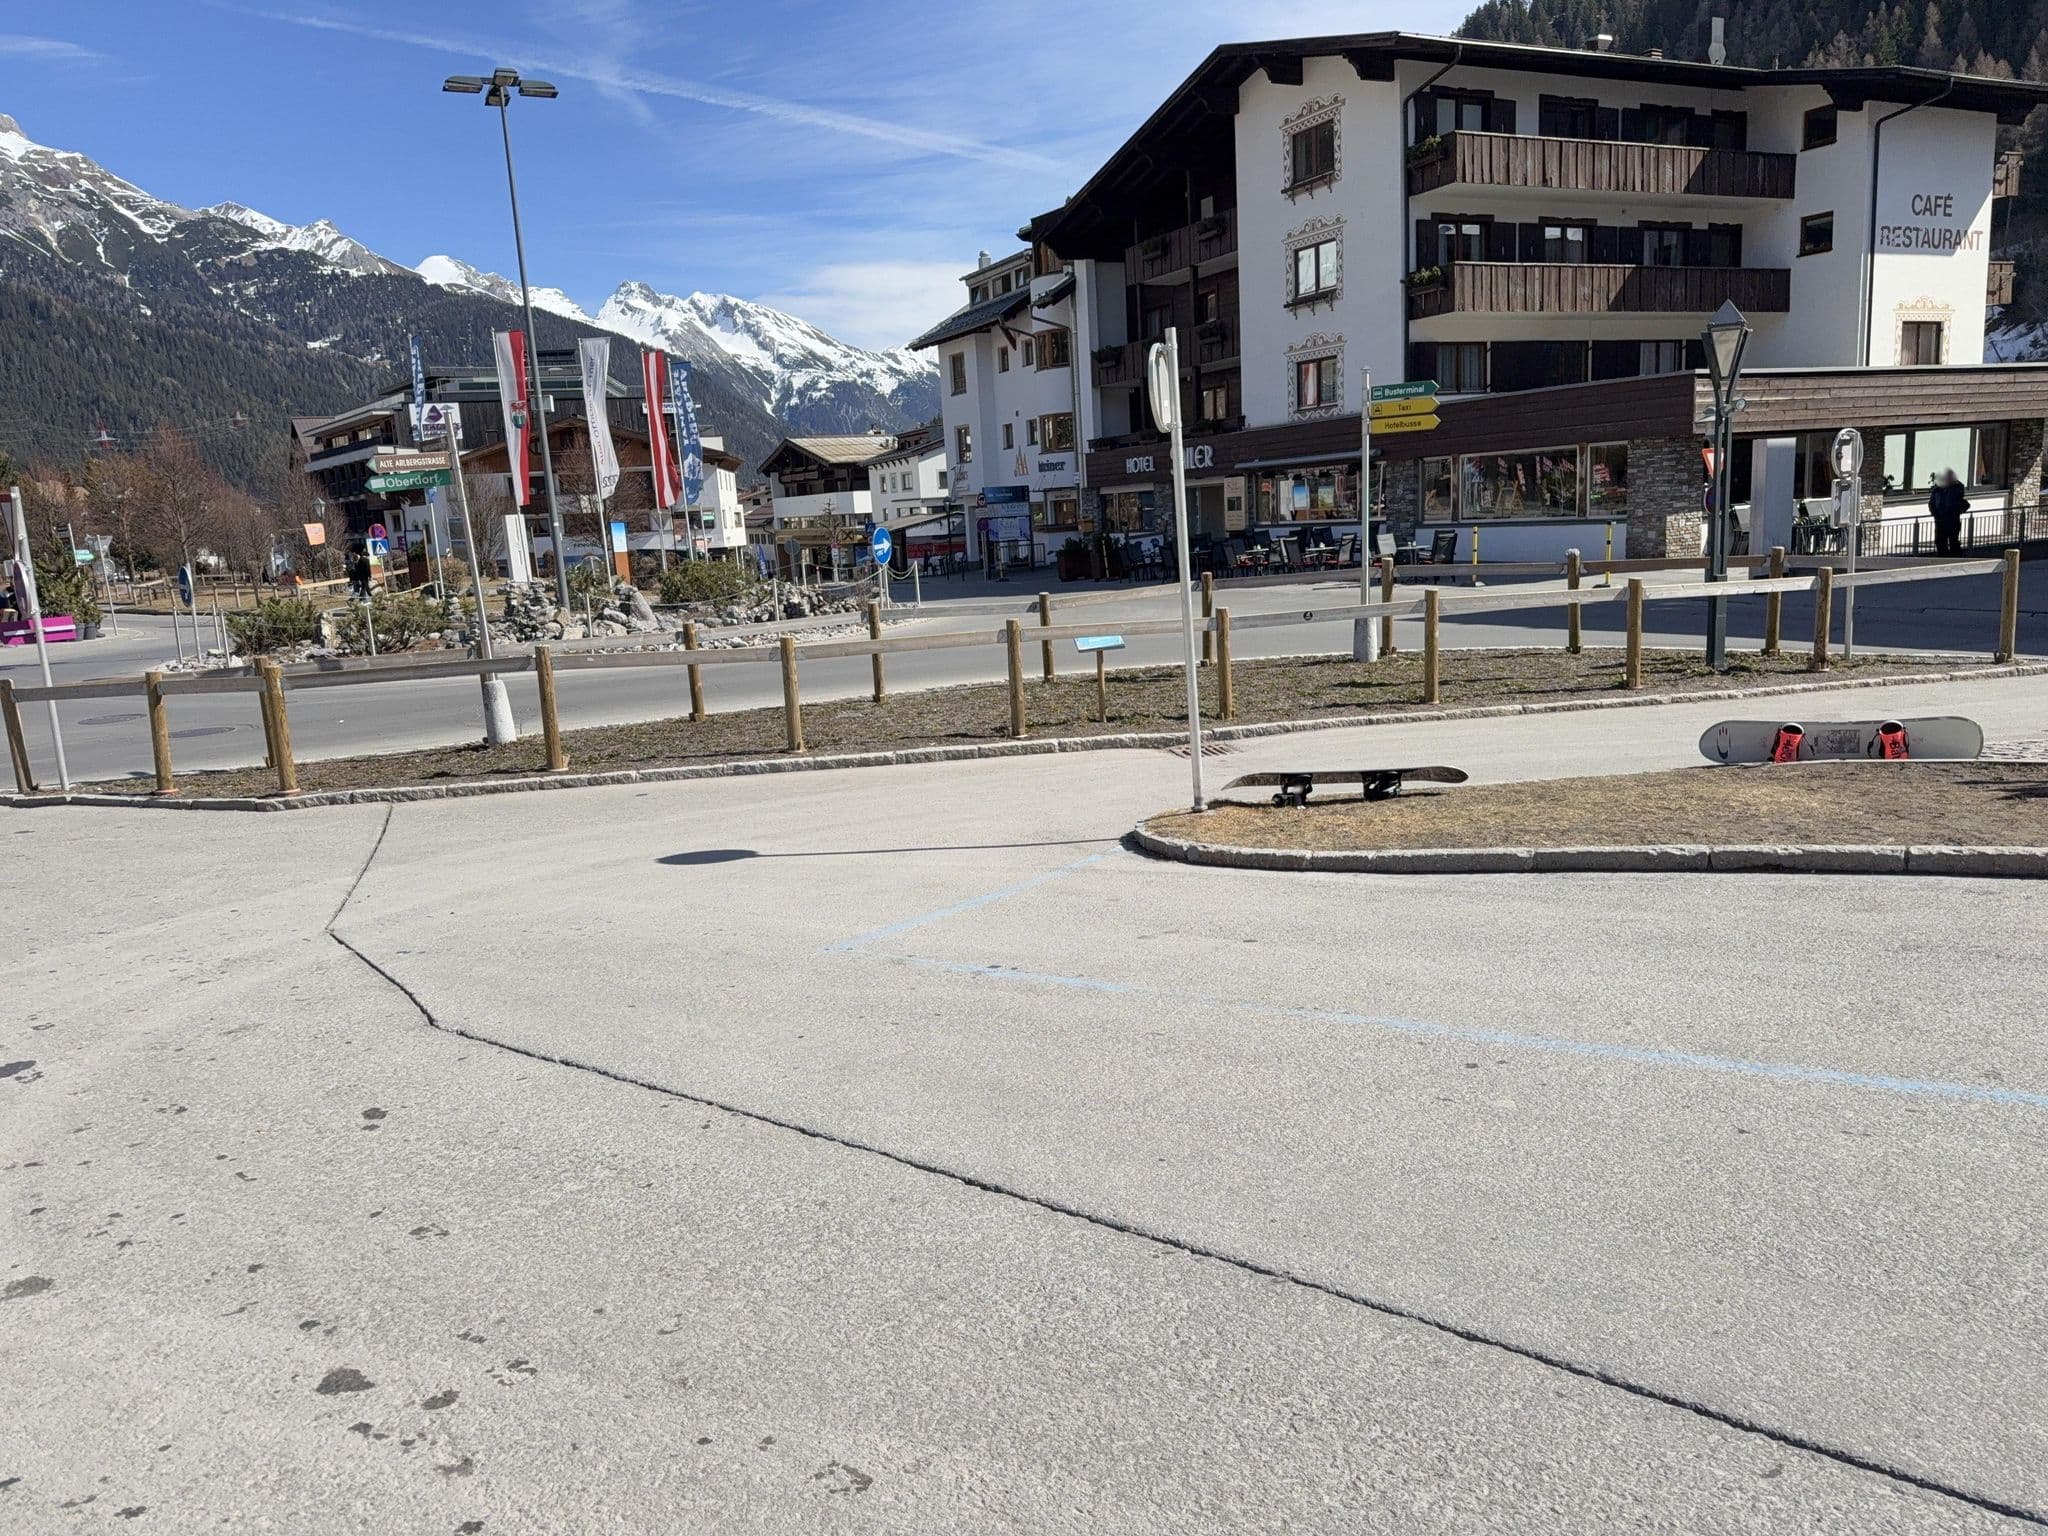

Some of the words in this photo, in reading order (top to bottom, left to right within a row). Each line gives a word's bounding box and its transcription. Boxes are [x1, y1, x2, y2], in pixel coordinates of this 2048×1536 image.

[1911, 192, 1953, 218] CAFÉ
[1879, 225, 1984, 251] RESTAURANT
[1384, 385, 1425, 396] Busterminal
[1397, 404, 1412, 412] Taxi
[1384, 420, 1422, 430] Hotelbusse
[379, 460, 393, 468] ALTE
[395, 457, 446, 468] ARLBERGSTRASSE
[1125, 455, 1156, 474] HOTEL
[385, 473, 439, 488] Oberdorf
